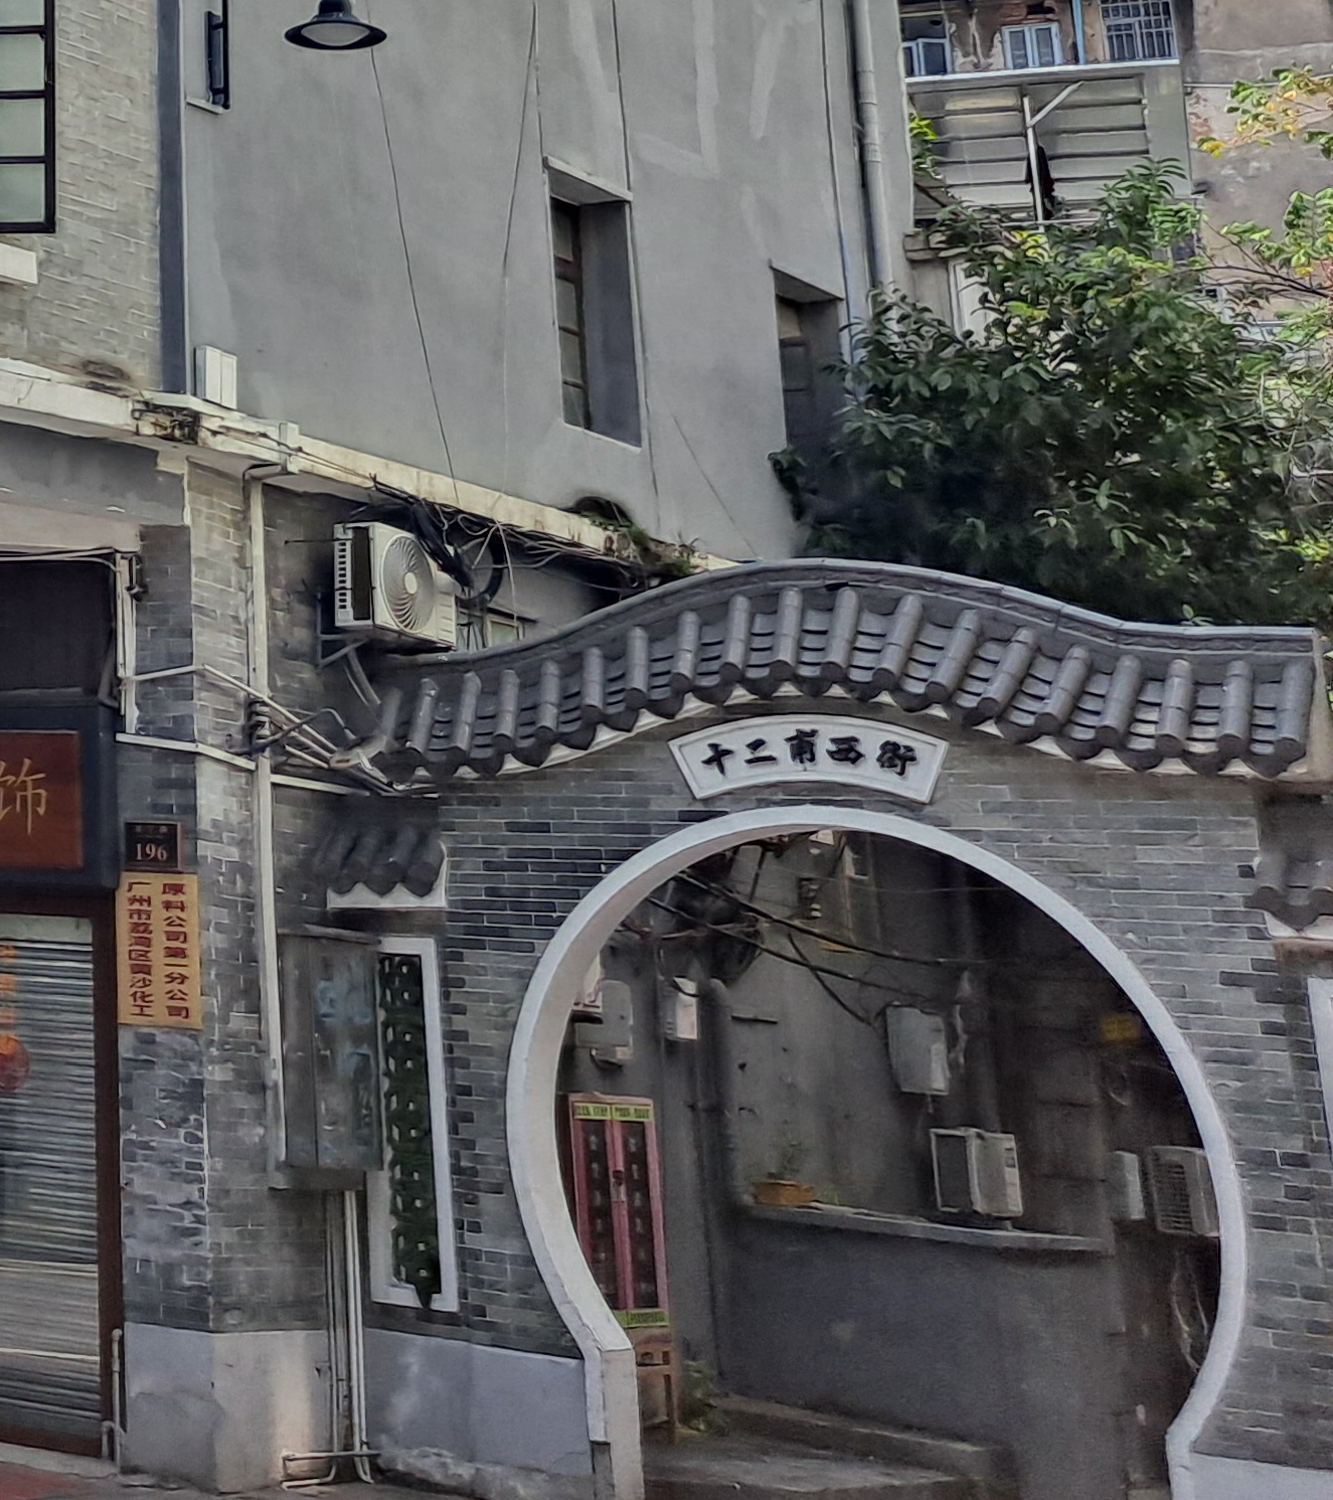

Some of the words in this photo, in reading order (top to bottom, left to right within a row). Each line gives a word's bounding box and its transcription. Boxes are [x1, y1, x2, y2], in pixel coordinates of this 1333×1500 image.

[701, 729, 917, 777] 十二甫西街
[136, 843, 167, 861] 196
[161, 882, 190, 1019] 原料公司第一分公司
